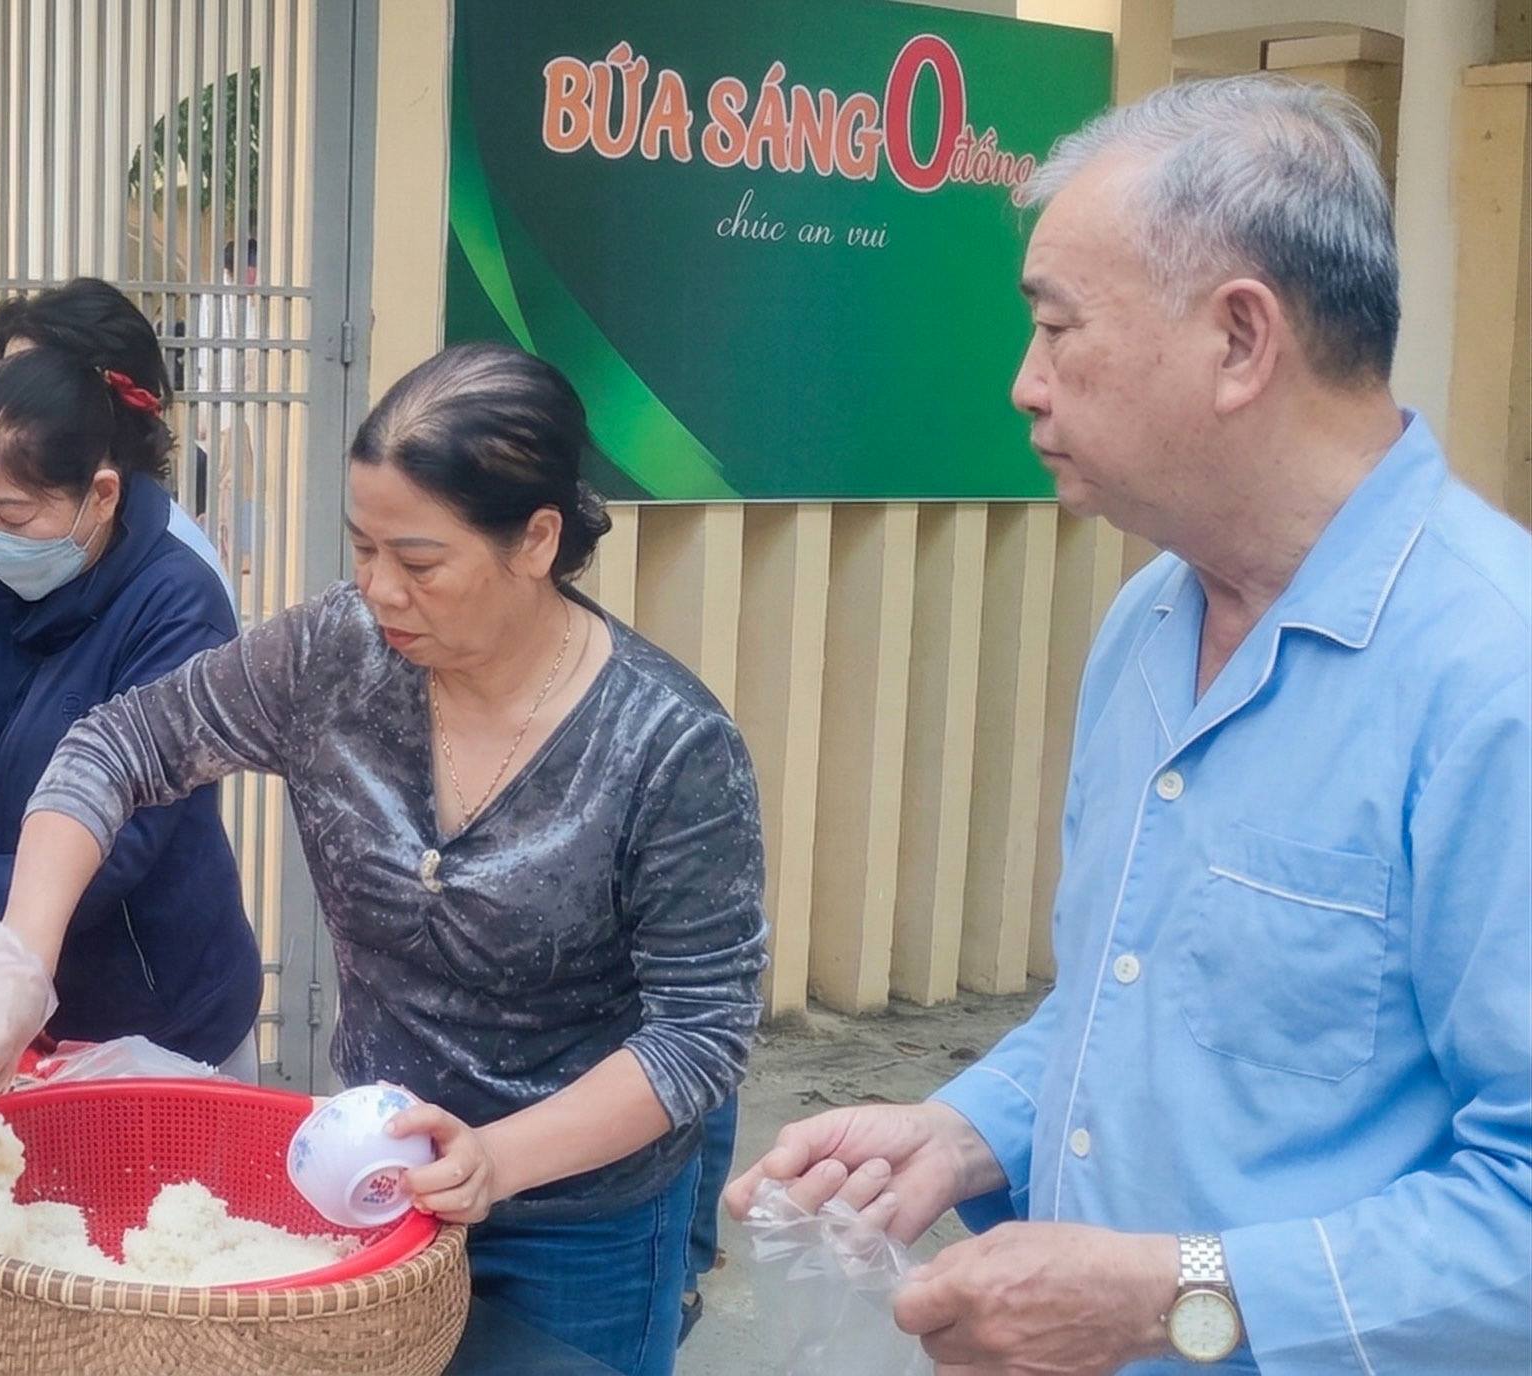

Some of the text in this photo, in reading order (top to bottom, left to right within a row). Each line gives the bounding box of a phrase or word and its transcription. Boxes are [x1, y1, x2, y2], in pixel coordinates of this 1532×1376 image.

[701, 60, 884, 181] SÁNG
[716, 188, 891, 248] chúc an vui
